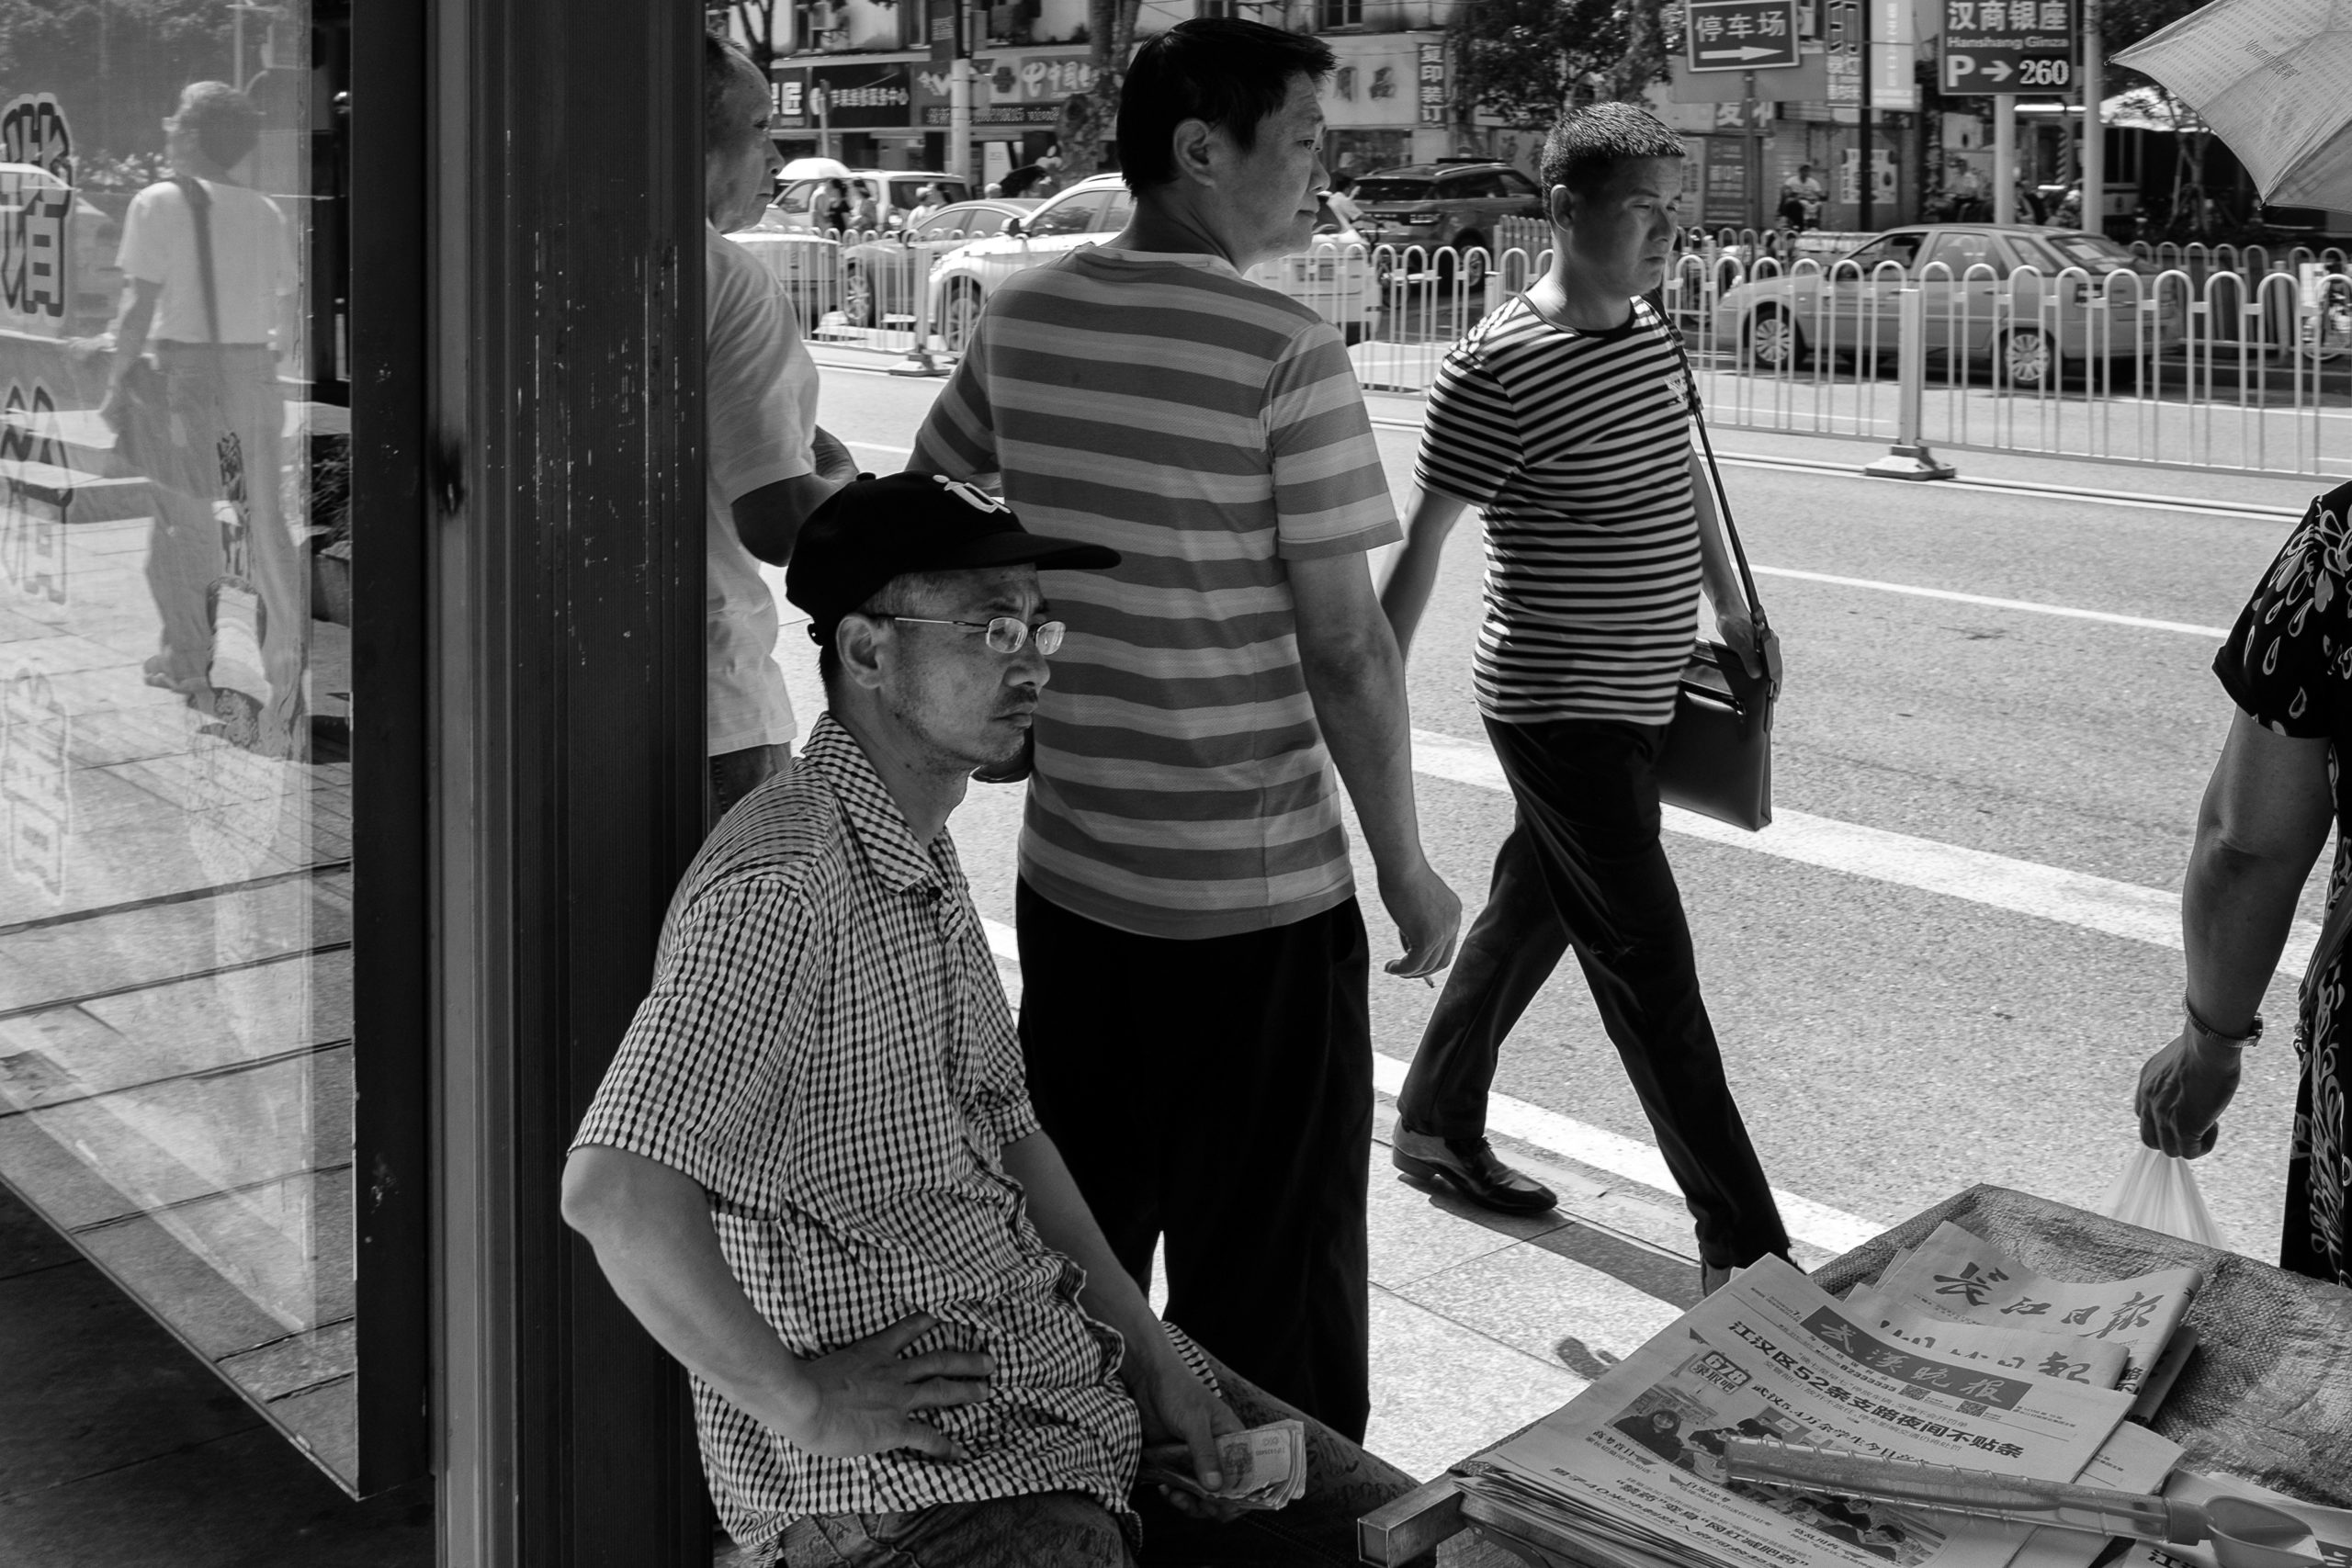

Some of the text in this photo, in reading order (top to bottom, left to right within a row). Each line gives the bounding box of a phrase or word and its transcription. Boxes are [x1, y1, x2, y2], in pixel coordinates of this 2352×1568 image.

[1695, 11, 1786, 42] 停车场
[1948, 0, 2068, 31] 汉商银座
[1946, 36, 2069, 50] Hanshang Ginza
[1420, 45, 1444, 121] 复印装订
[1947, 55, 2069, 87] P 260
[1691, 1362, 1737, 1394] 录取吧
[1705, 1354, 1749, 1386] 678
[1840, 1363, 1897, 1393] 82333333
[1728, 1320, 2025, 1459] 江汉区52条支路夜间不贴条
